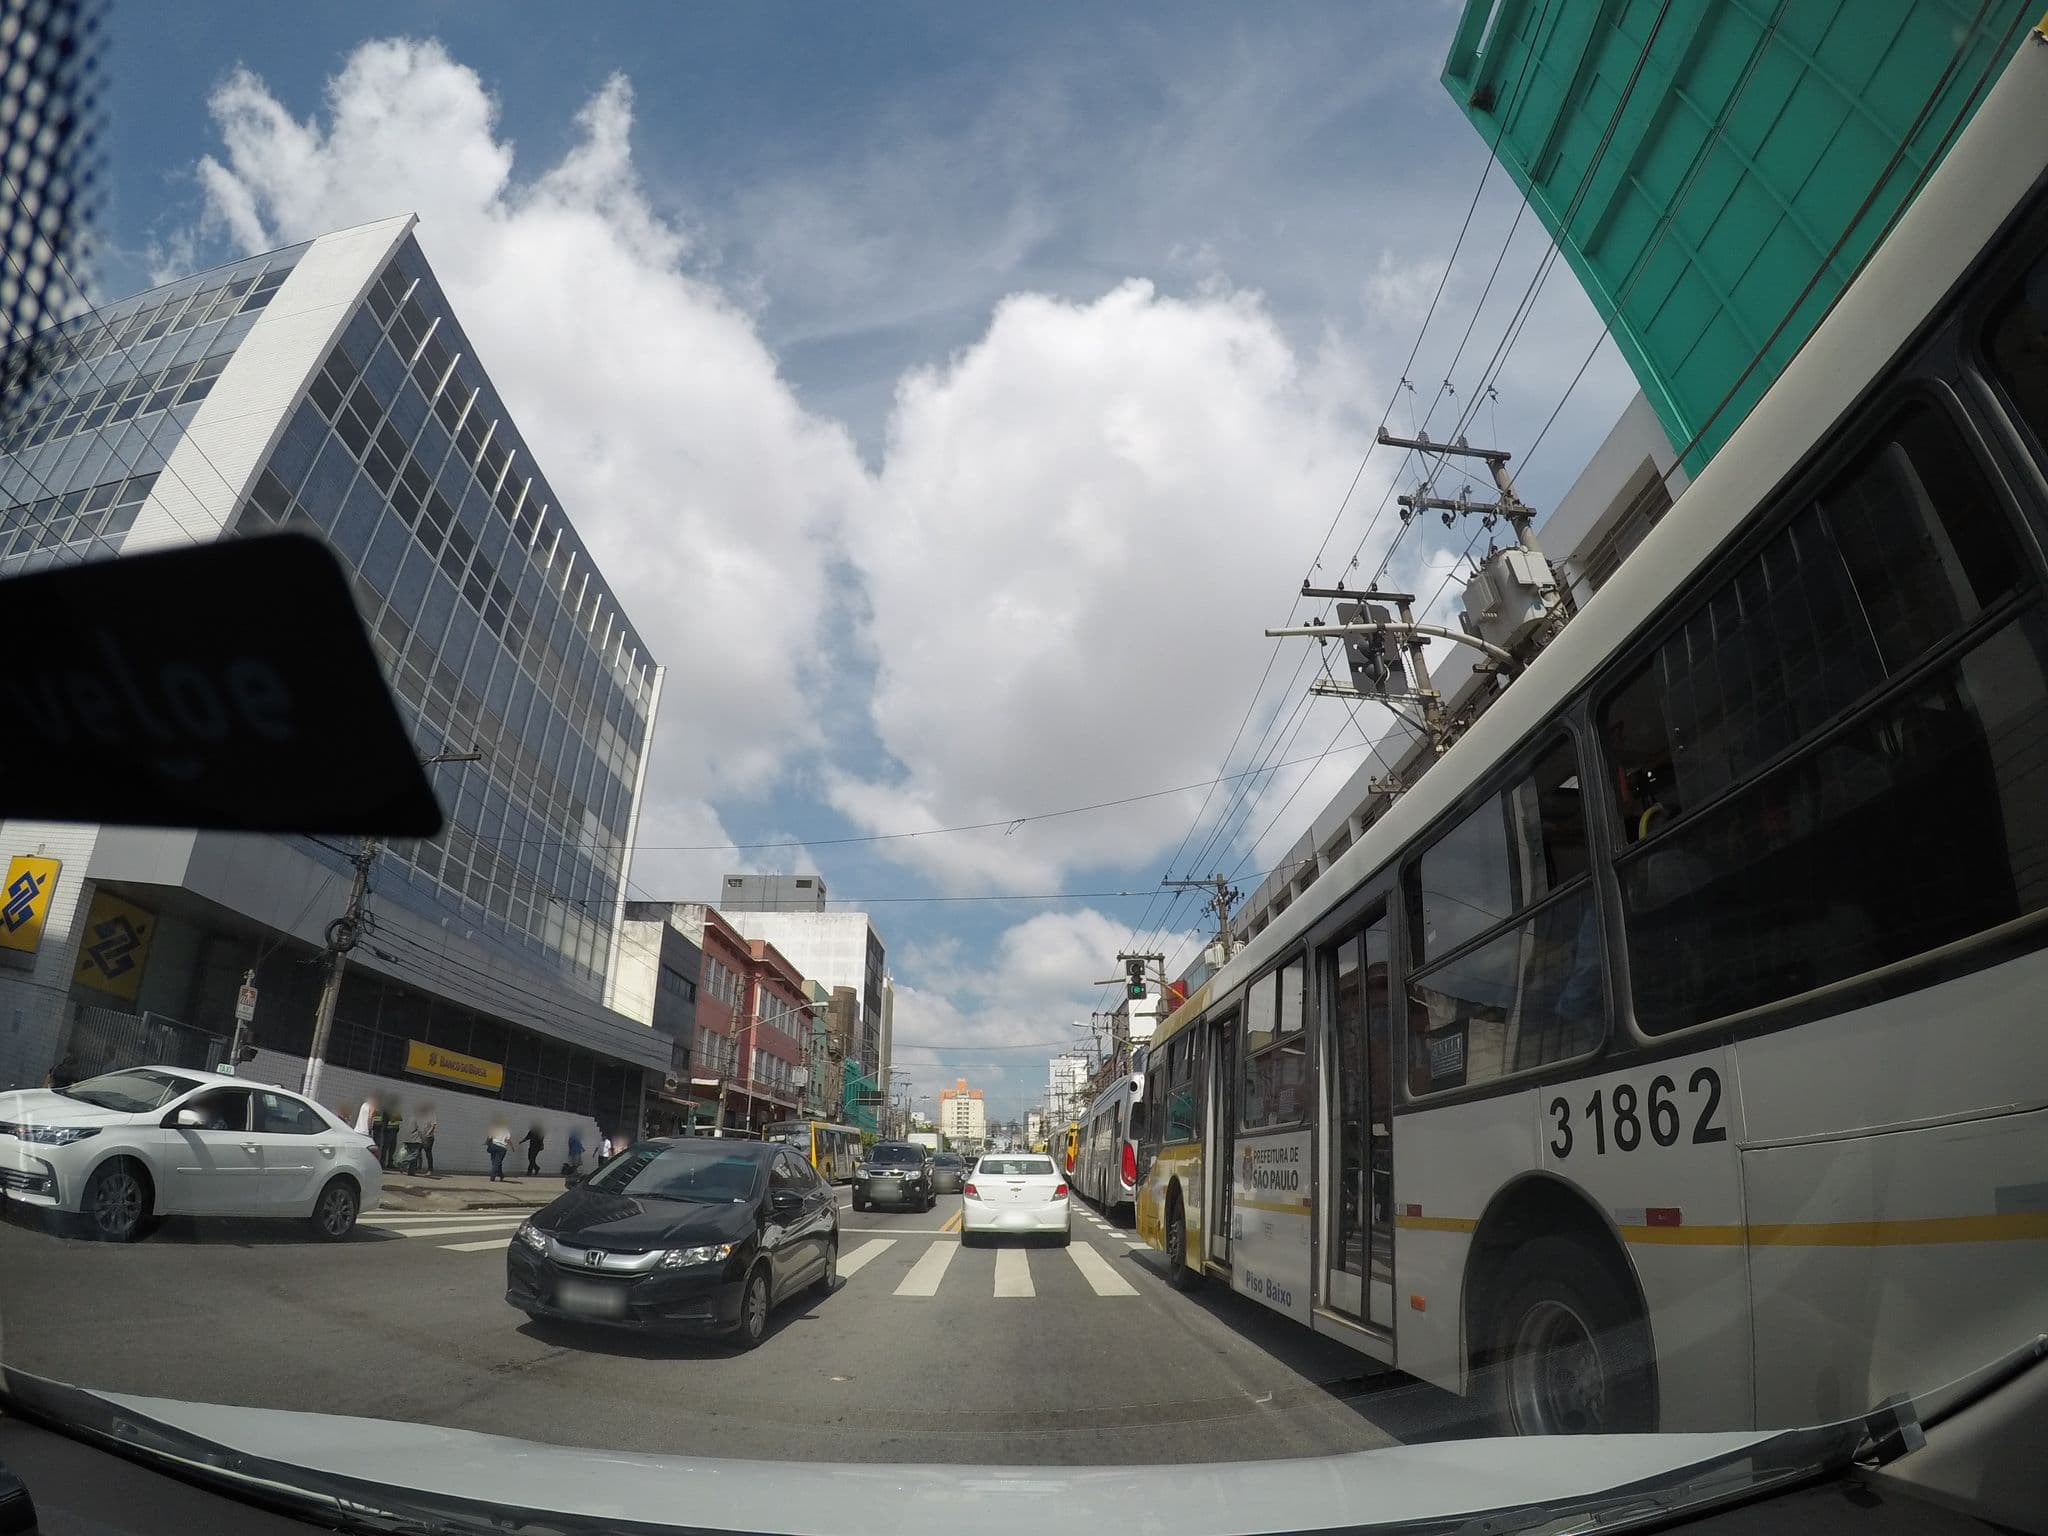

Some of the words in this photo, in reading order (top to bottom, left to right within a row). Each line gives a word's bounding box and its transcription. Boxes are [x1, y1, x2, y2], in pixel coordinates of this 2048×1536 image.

[1254, 1148, 1288, 1164] PREFEITURA
[1289, 1146, 1299, 1162] DE
[1253, 1166, 1269, 1190] SÃO
[1270, 1169, 1299, 1191] PAULO
[1246, 1270, 1263, 1293] Piso
[1266, 1279, 1292, 1308] Baixo
